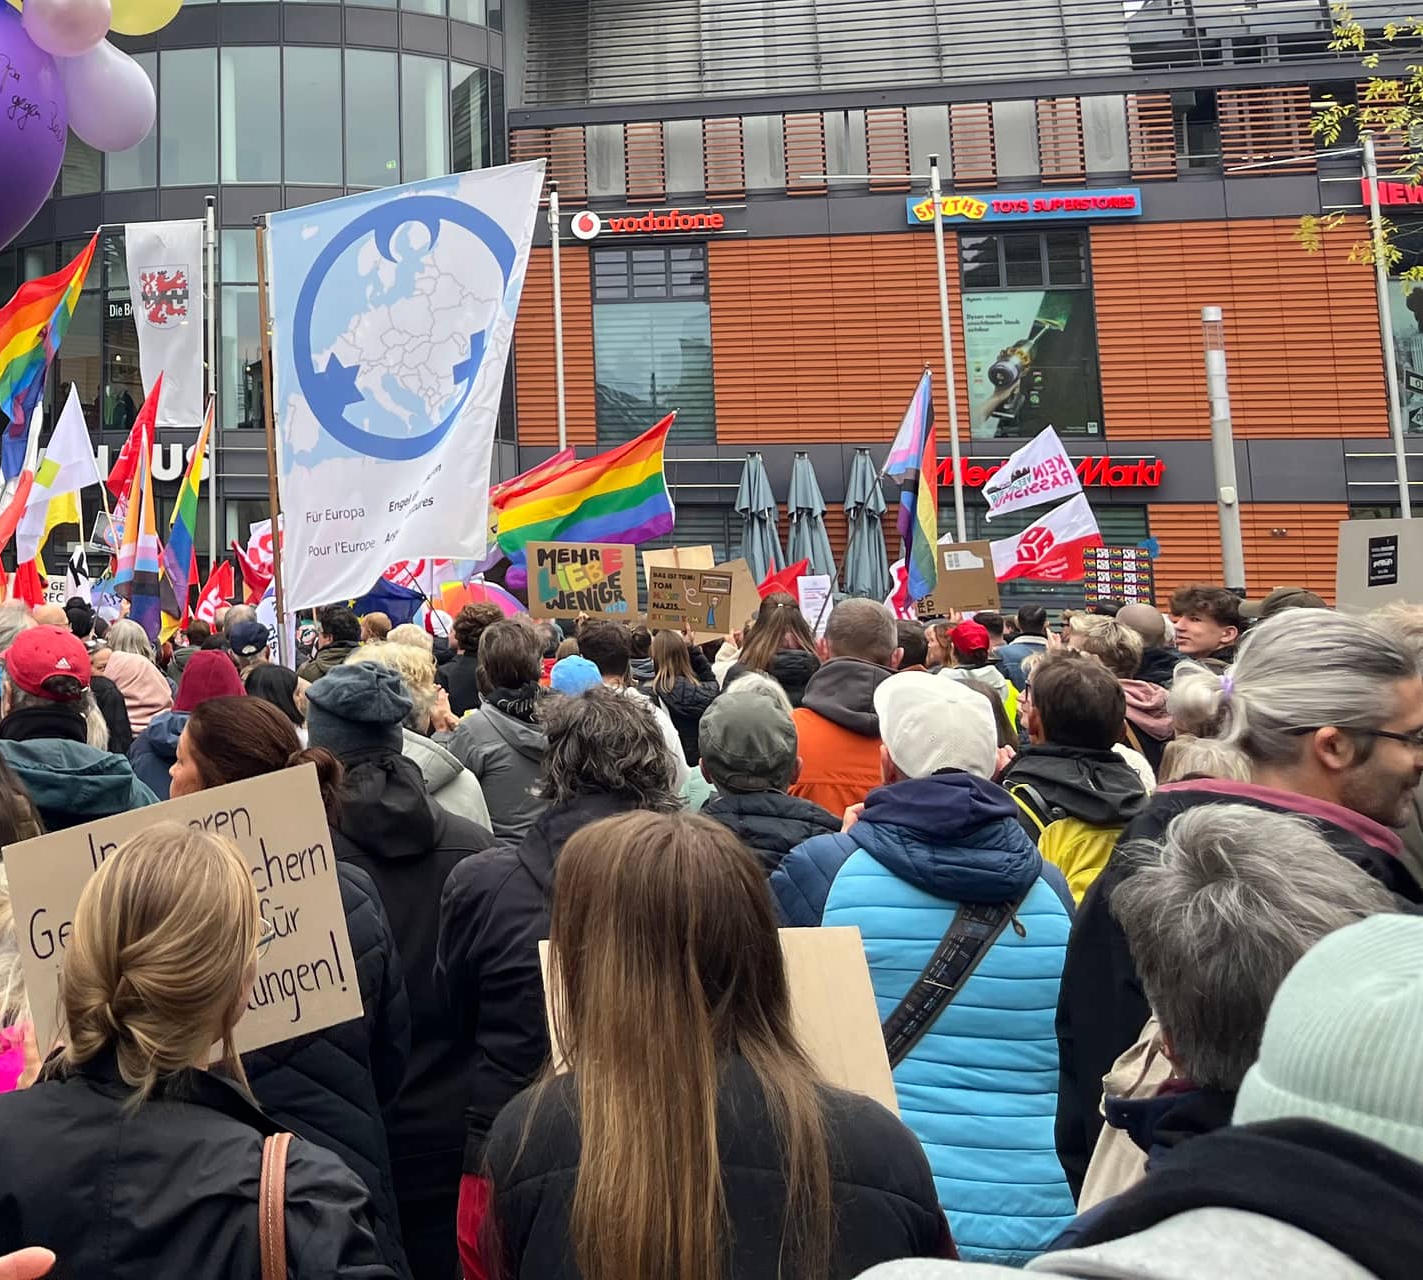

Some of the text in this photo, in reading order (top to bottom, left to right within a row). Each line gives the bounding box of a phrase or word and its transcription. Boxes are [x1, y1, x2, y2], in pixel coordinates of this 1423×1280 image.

[991, 199, 1029, 214] TOYS
[1032, 195, 1136, 213] SUPERSTORES
[609, 209, 725, 233] vodafone
[109, 304, 123, 317] Die
[1076, 455, 1166, 487] Markt
[306, 510, 322, 524] Für
[325, 506, 365, 522] Europa
[308, 544, 332, 557] Pour
[537, 548, 600, 575] MEHR
[653, 582, 673, 590] TOM
